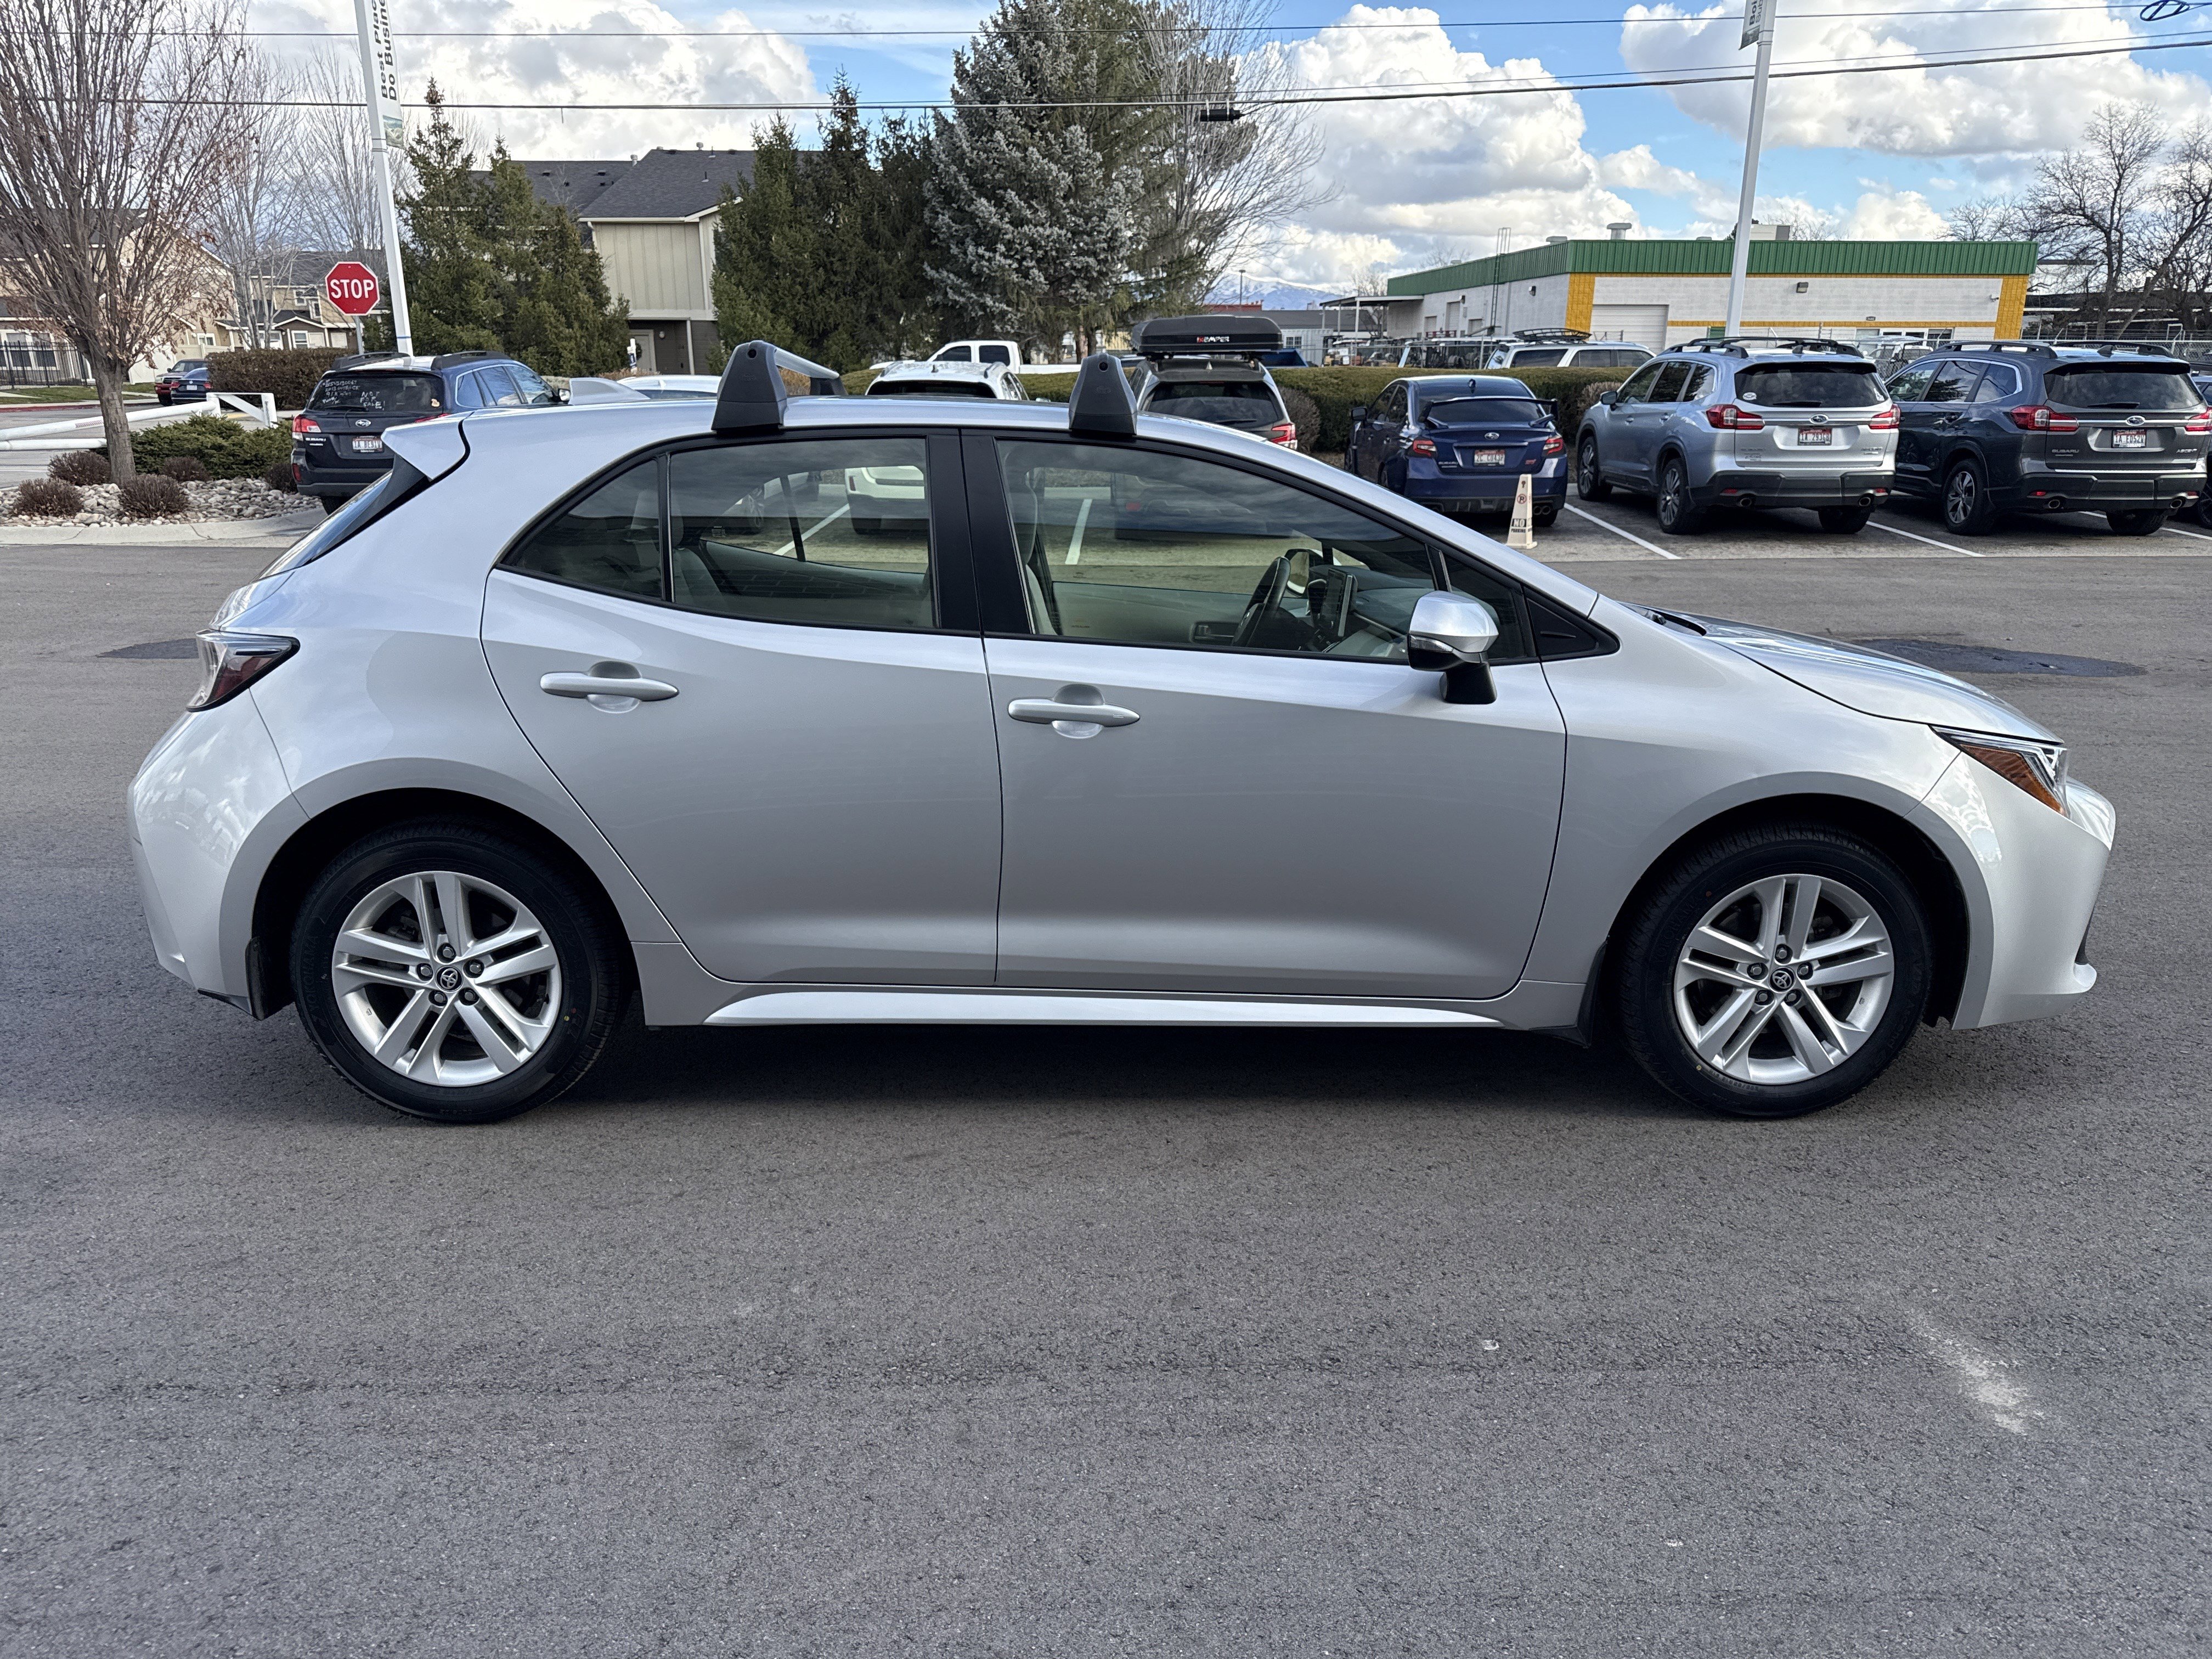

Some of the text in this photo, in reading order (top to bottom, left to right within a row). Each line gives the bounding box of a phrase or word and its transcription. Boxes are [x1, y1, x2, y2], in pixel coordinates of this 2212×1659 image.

[377, 51, 388, 98] Best
[389, 74, 397, 100] Do
[330, 279, 374, 298] STOP
[1514, 518, 1525, 527] NO
